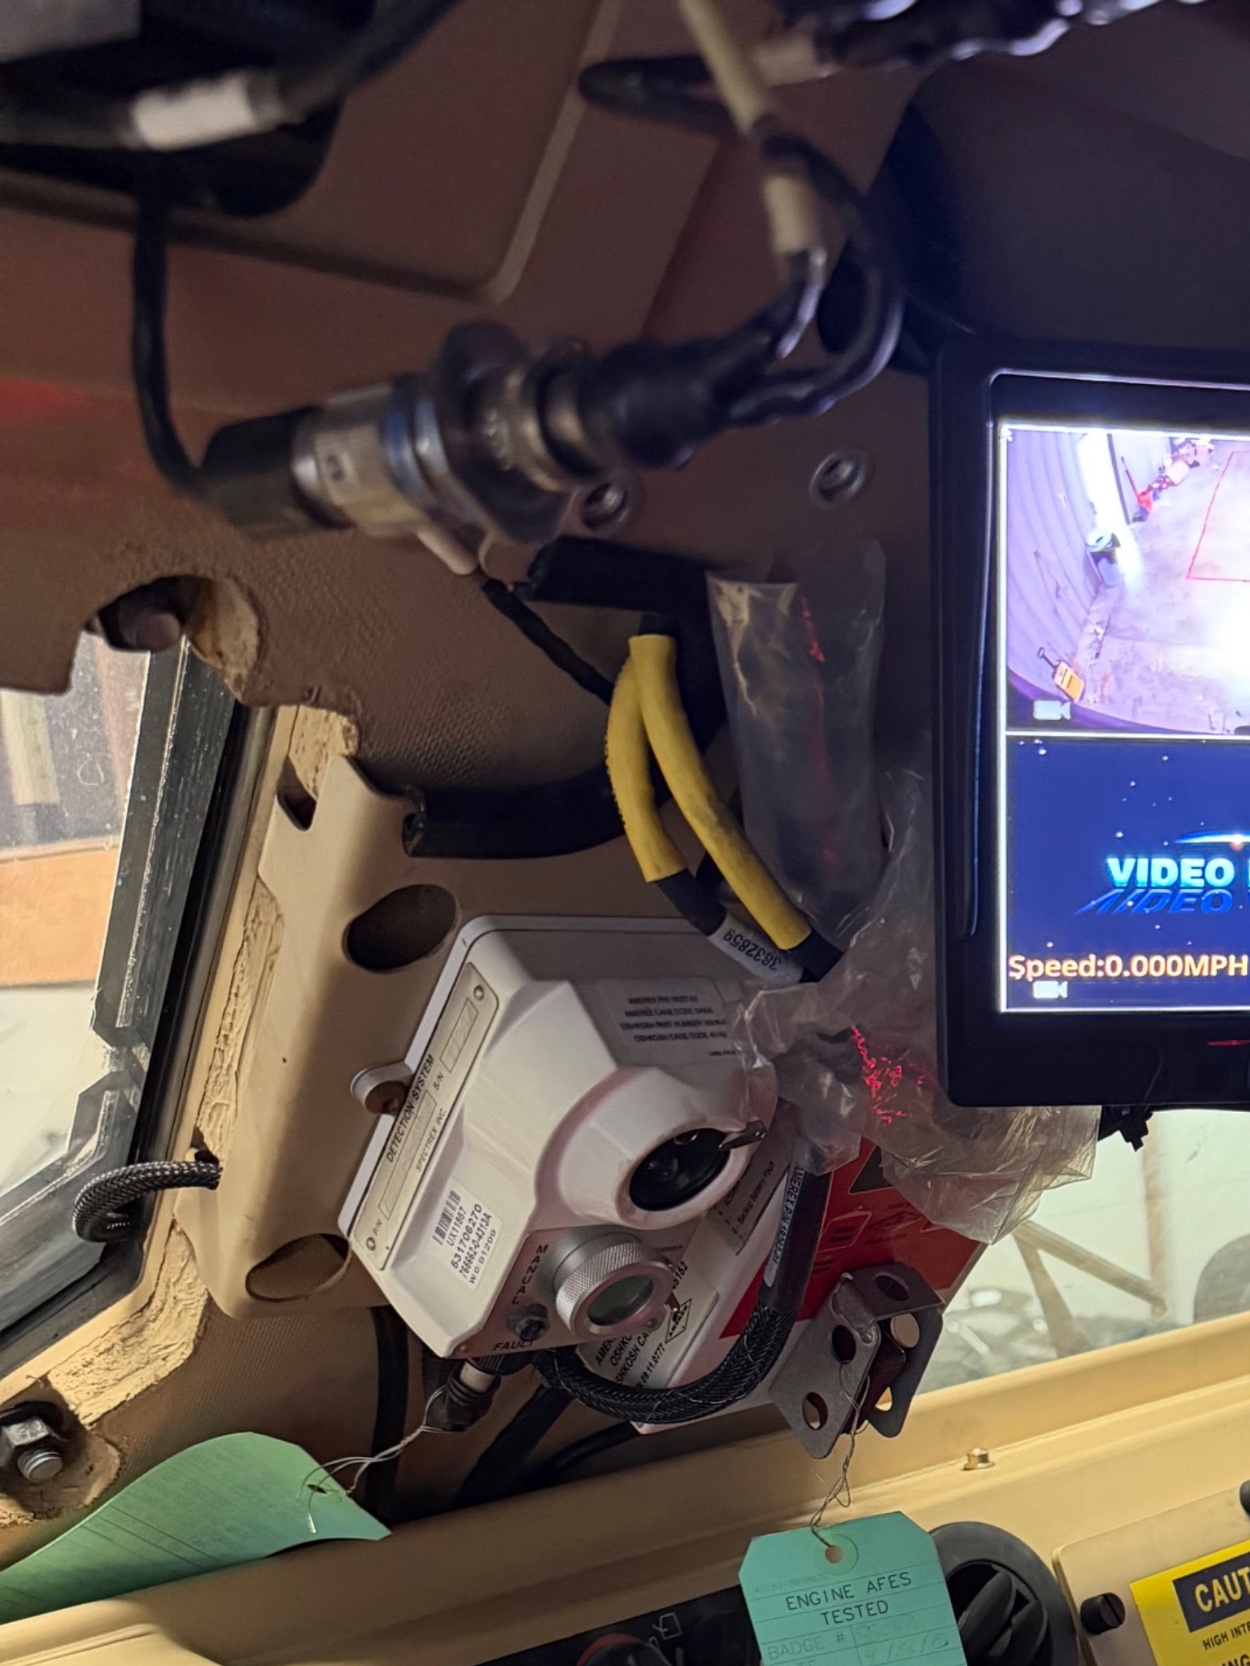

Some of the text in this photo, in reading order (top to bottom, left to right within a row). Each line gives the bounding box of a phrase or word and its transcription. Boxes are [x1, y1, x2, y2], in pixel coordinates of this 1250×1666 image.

[1107, 858, 1234, 887] VIDEO
[1008, 954, 1248, 980] Speed:0.000MPH
[385, 1053, 437, 1162] DETECTION SYSTEM
[512, 1245, 549, 1304] MANUAL
[493, 1339, 534, 1351] FAULT
[786, 1584, 855, 1611] ENGINE
[865, 1571, 912, 1594] AFES
[821, 1599, 889, 1627] TESTED
[767, 1632, 846, 1661] BADGE #
[1203, 1632, 1229, 1651] HIGH
